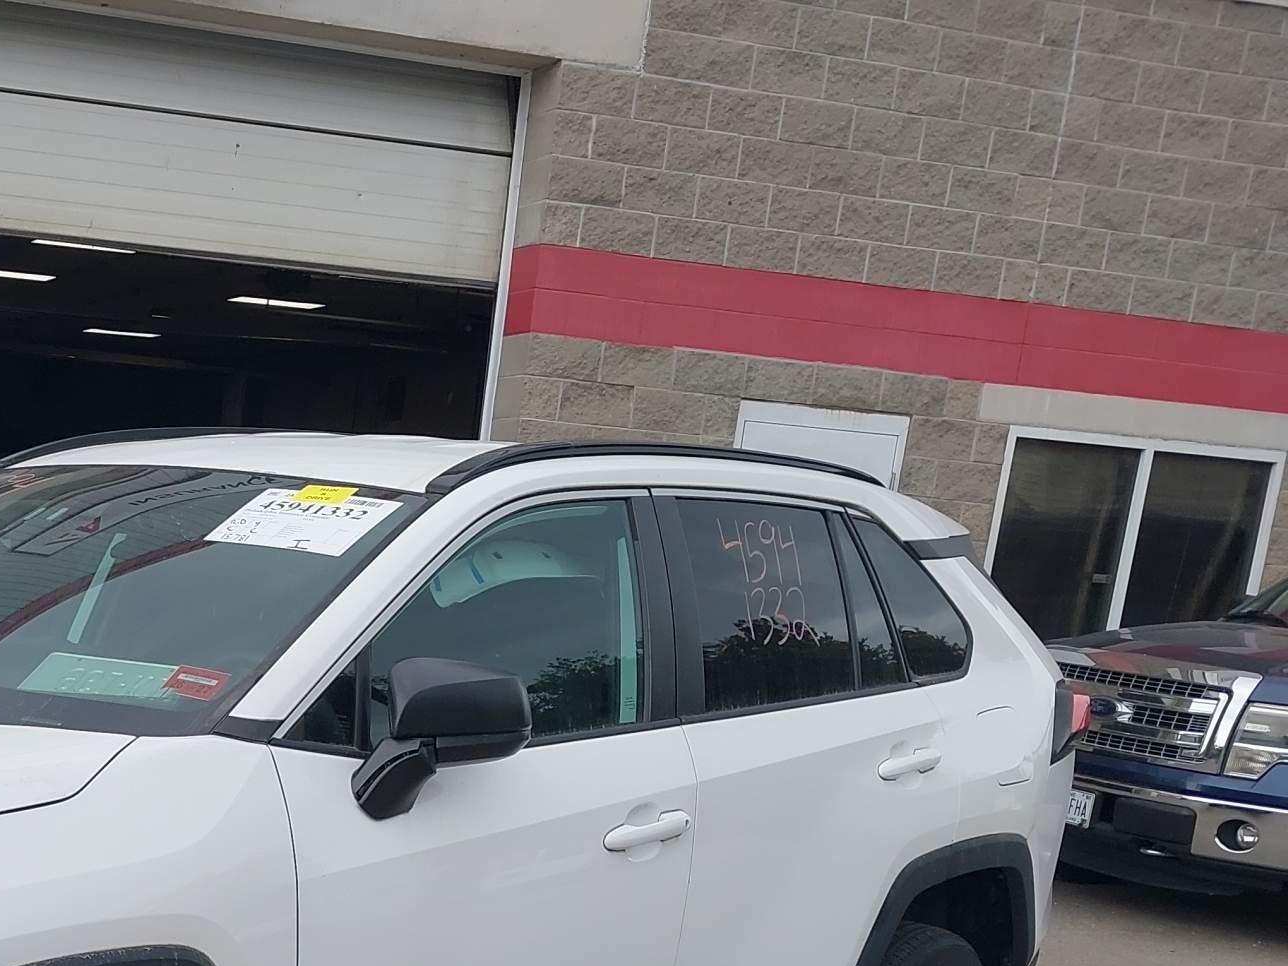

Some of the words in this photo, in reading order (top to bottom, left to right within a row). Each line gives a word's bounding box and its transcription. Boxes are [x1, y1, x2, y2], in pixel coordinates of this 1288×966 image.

[259, 499, 369, 521] 45941332
[716, 517, 802, 586] 4594
[744, 586, 820, 648] 1332
